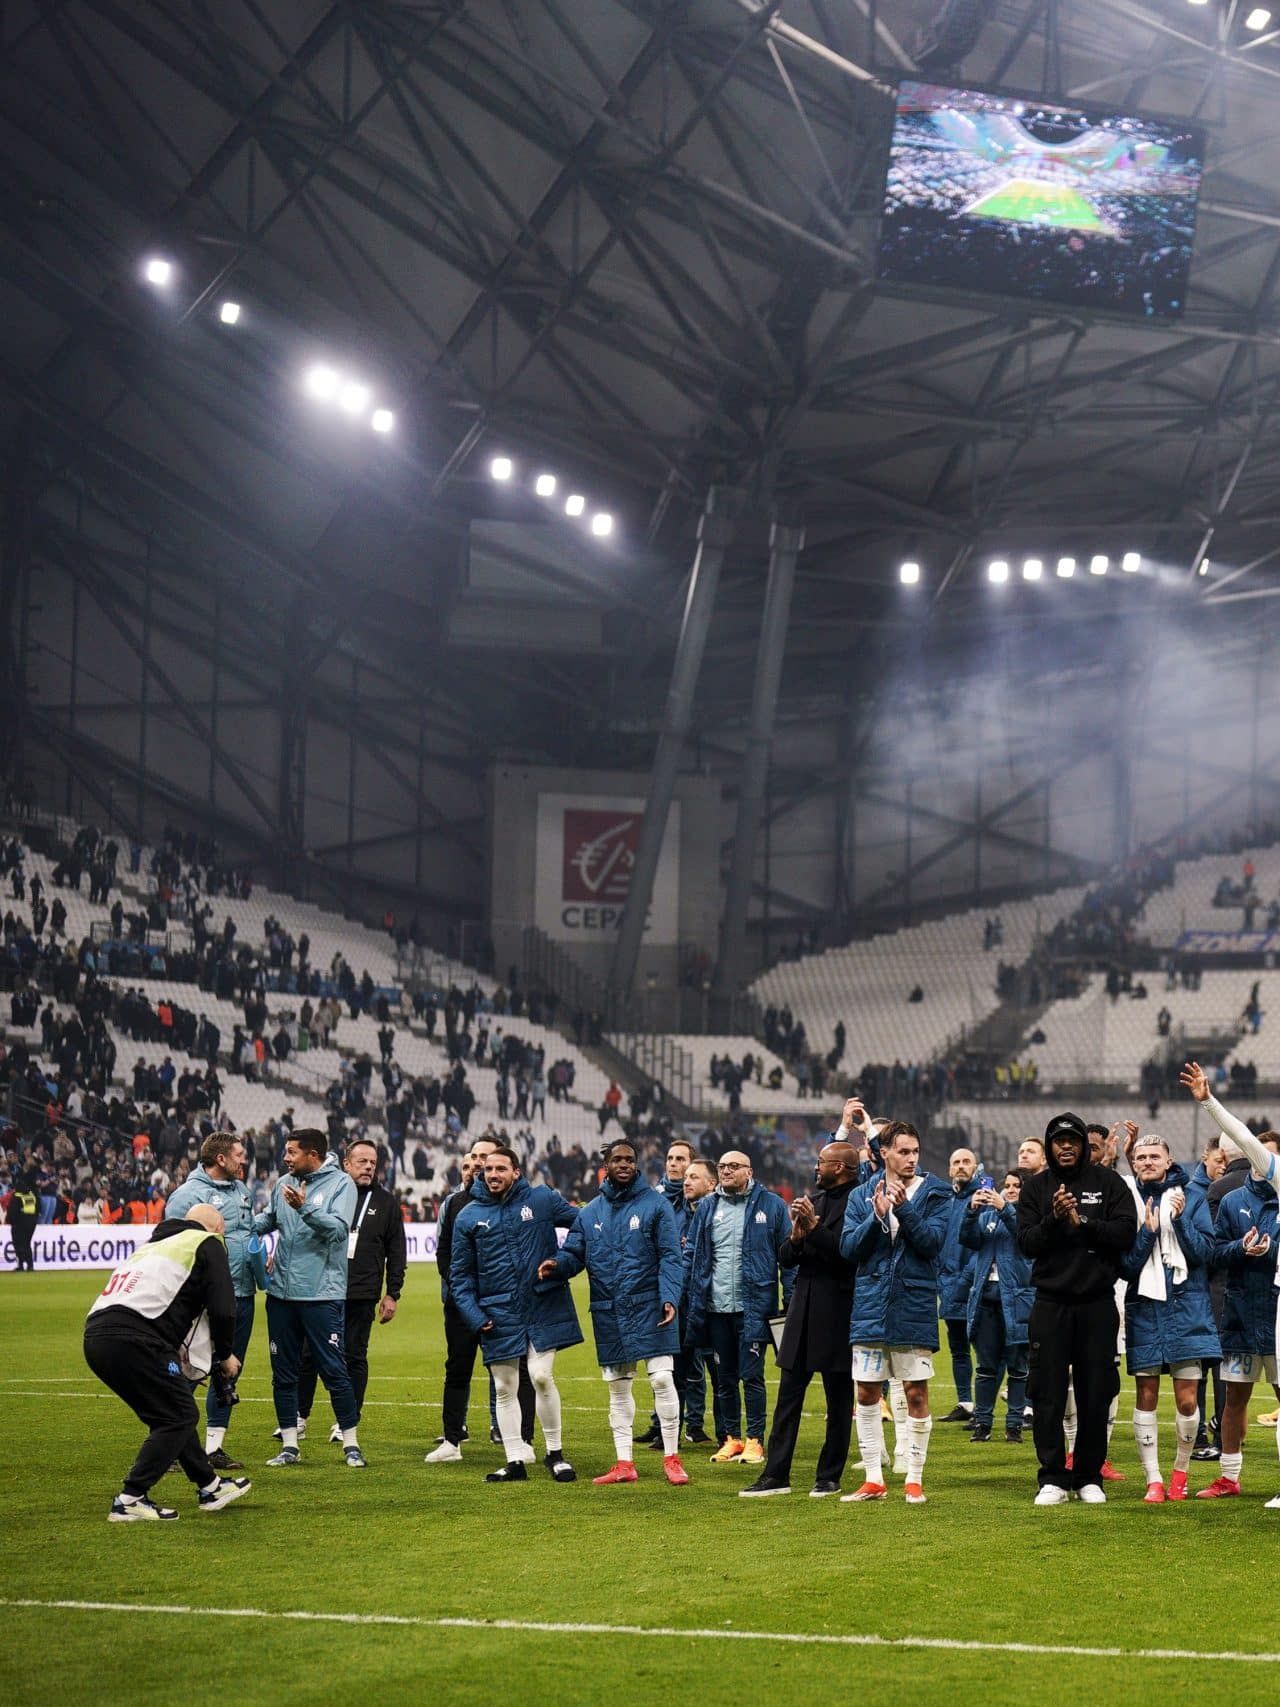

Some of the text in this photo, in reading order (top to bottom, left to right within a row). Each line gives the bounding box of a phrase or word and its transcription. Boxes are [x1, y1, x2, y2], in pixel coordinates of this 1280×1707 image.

[561, 907, 652, 930] CEP
[0, 1234, 135, 1263] erute.com
[861, 1350, 882, 1373] 77
[1230, 1353, 1253, 1375] 29
